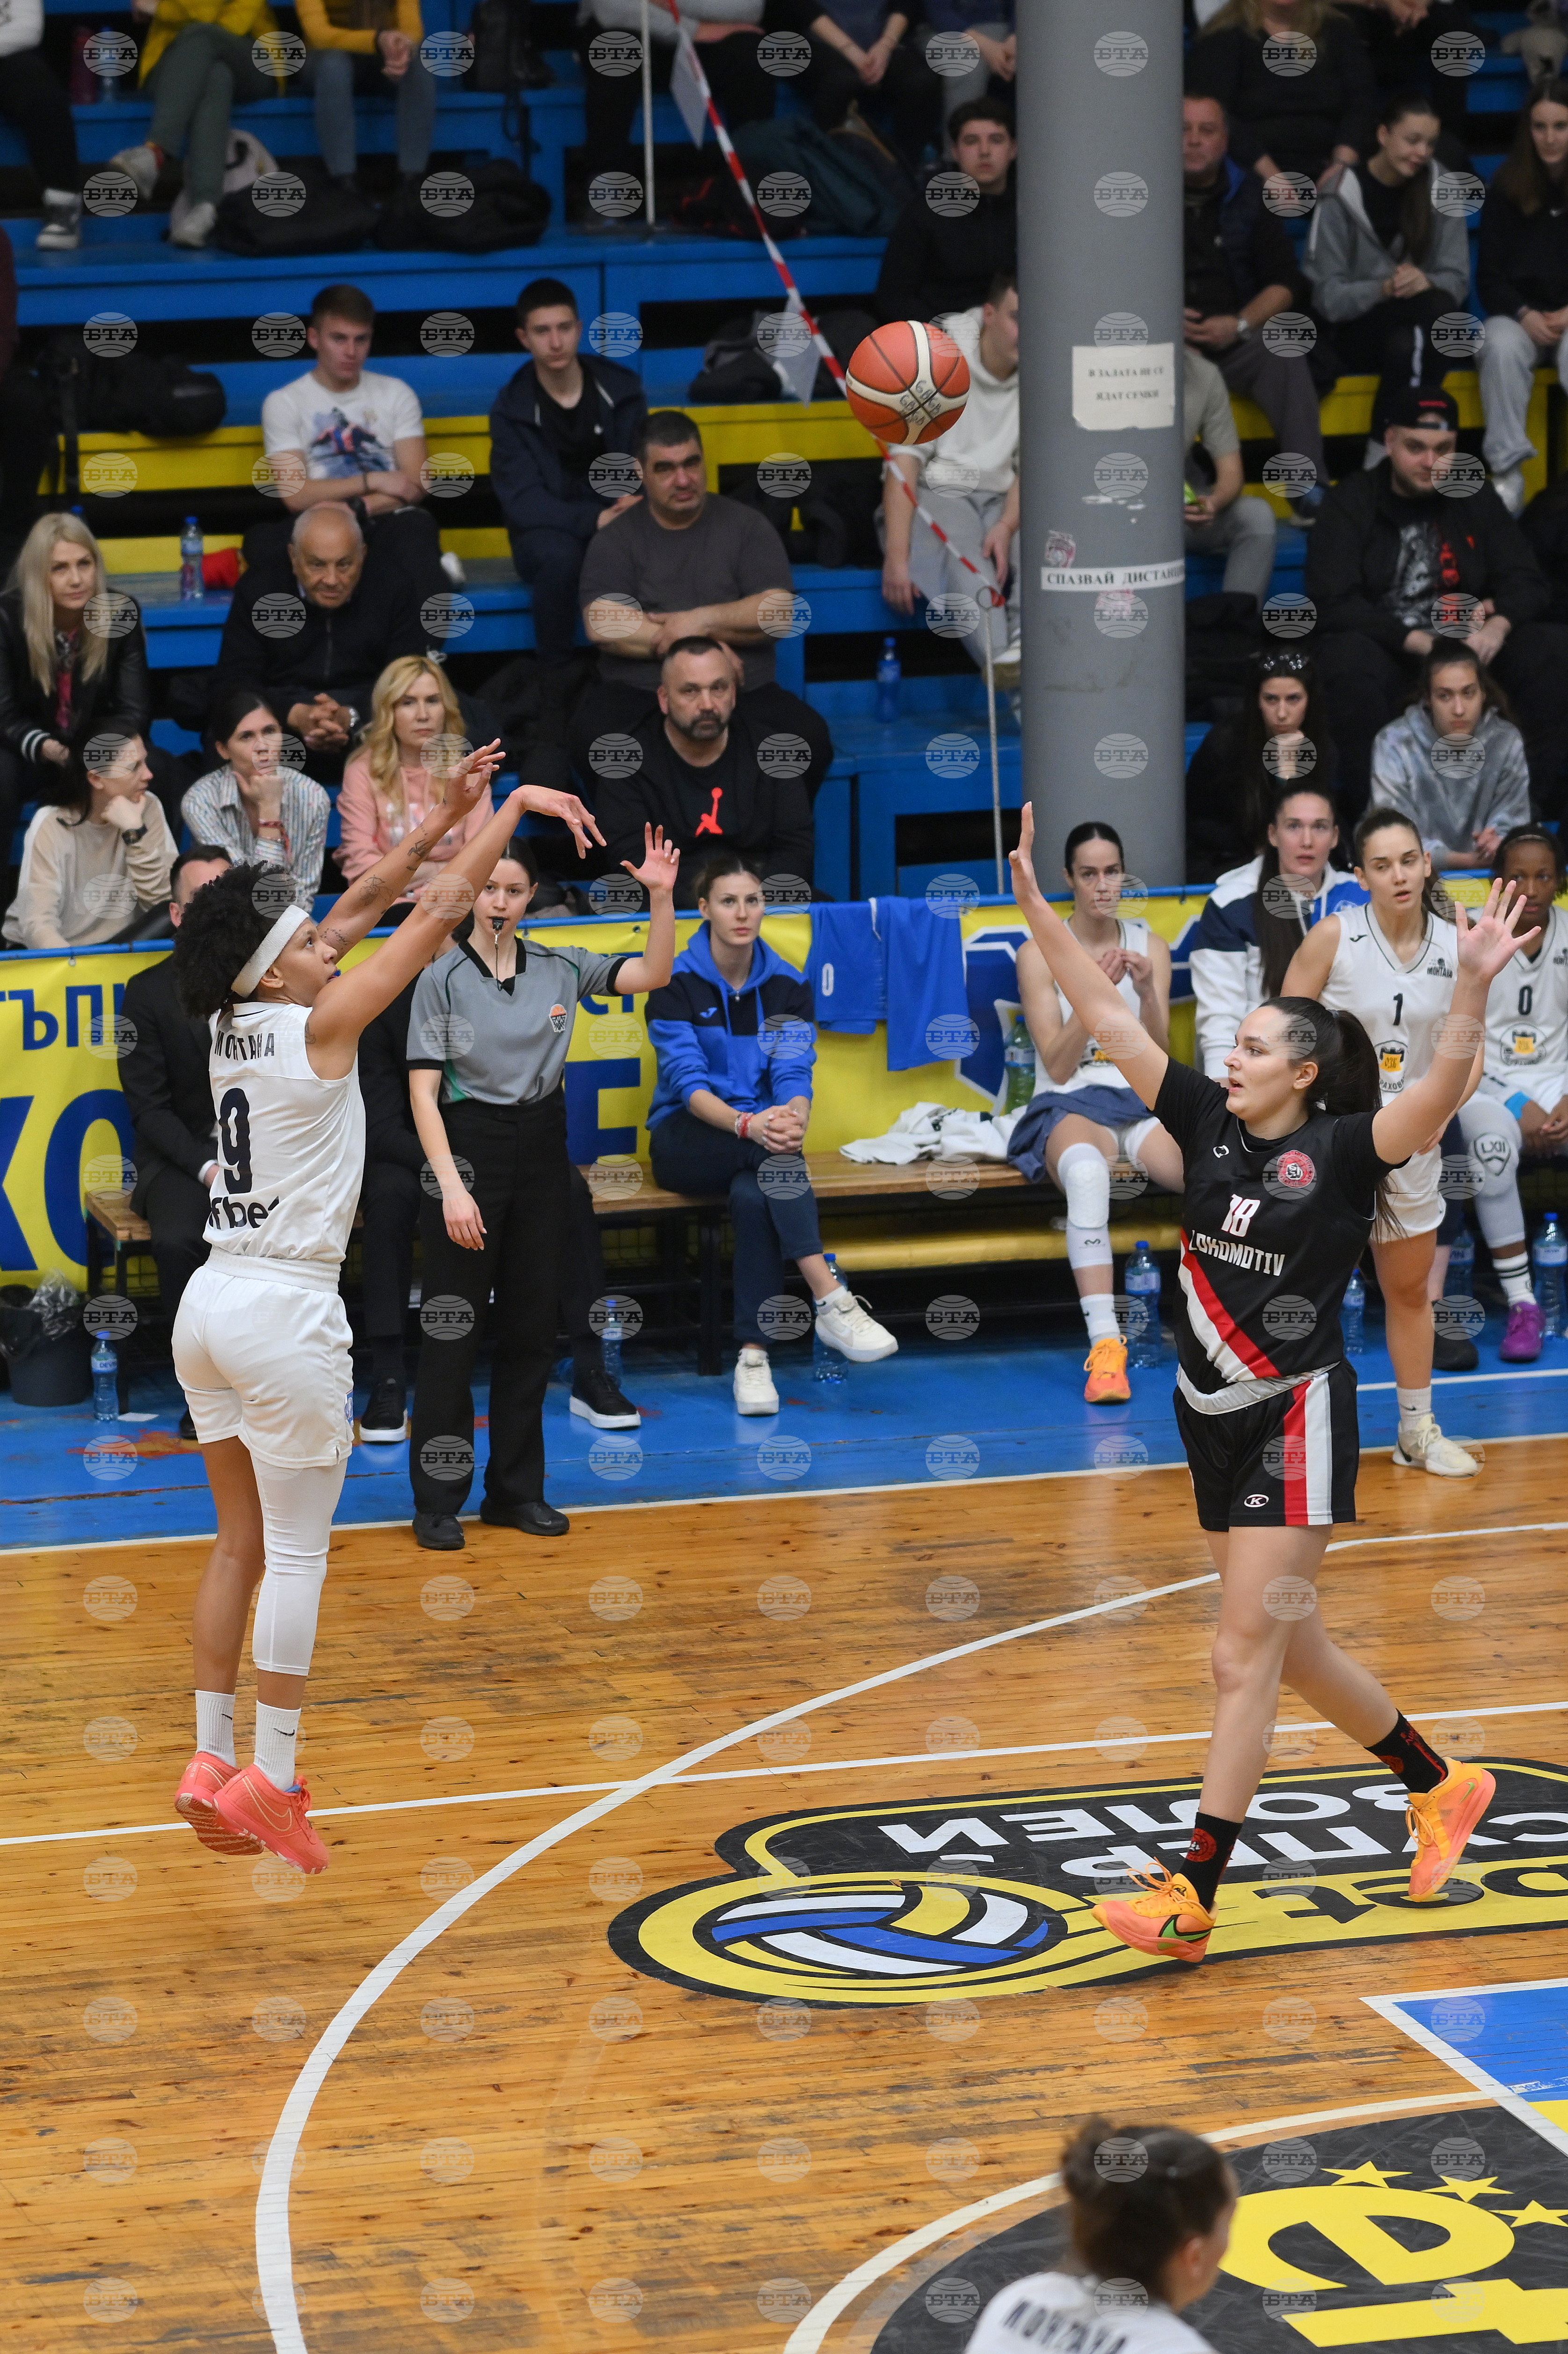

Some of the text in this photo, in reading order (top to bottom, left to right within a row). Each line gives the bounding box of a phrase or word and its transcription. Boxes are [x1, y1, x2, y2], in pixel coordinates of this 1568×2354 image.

[1047, 570, 1114, 584] СПАЗВАЙ
[1393, 993, 1403, 1026] 1
[1518, 985, 1532, 1016] 0
[214, 1031, 275, 1060] МОНТАНА
[219, 1088, 253, 1194] 9
[1221, 1194, 1261, 1237] 18
[1189, 1229, 1285, 1276] LOKOMOTIV
